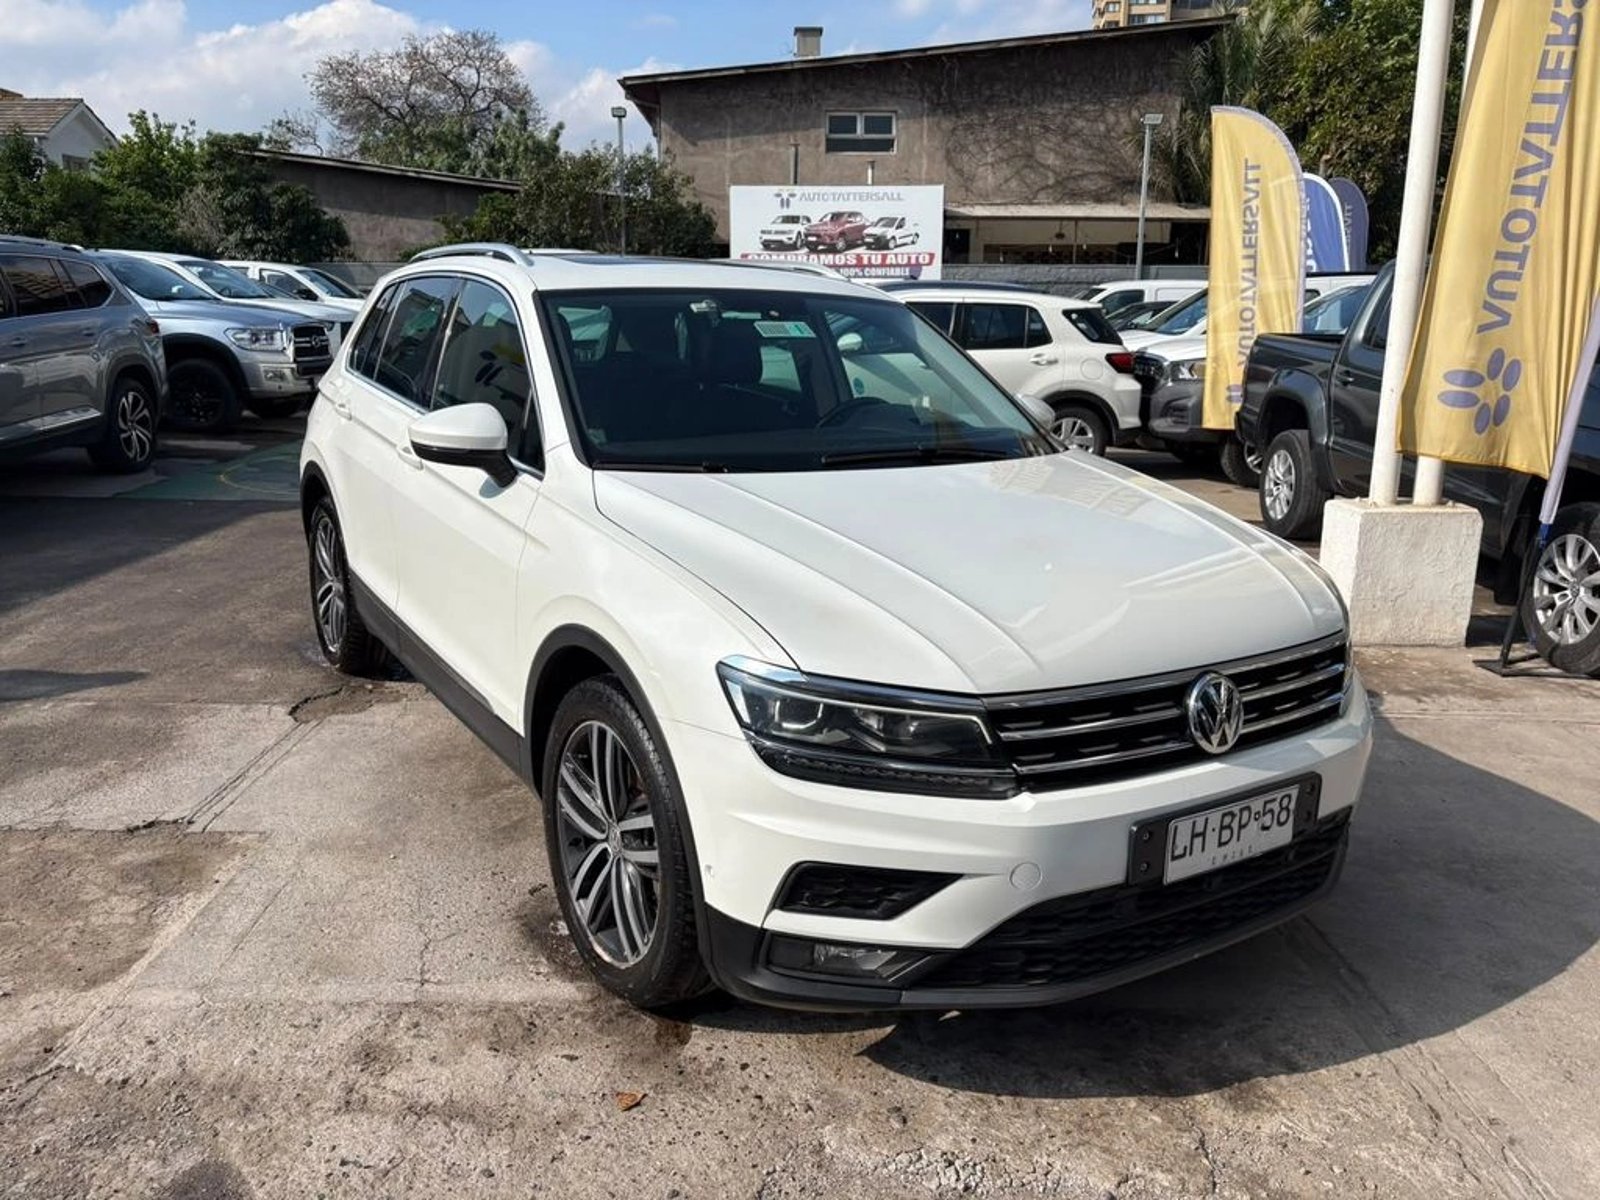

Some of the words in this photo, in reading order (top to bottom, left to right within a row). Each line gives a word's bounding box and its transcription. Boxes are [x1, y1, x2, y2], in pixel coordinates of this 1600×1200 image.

[860, 253, 882, 266] TU
[885, 253, 930, 266] AUTO
[840, 267, 863, 277] 100%
[864, 267, 909, 277] CONFIABLE
